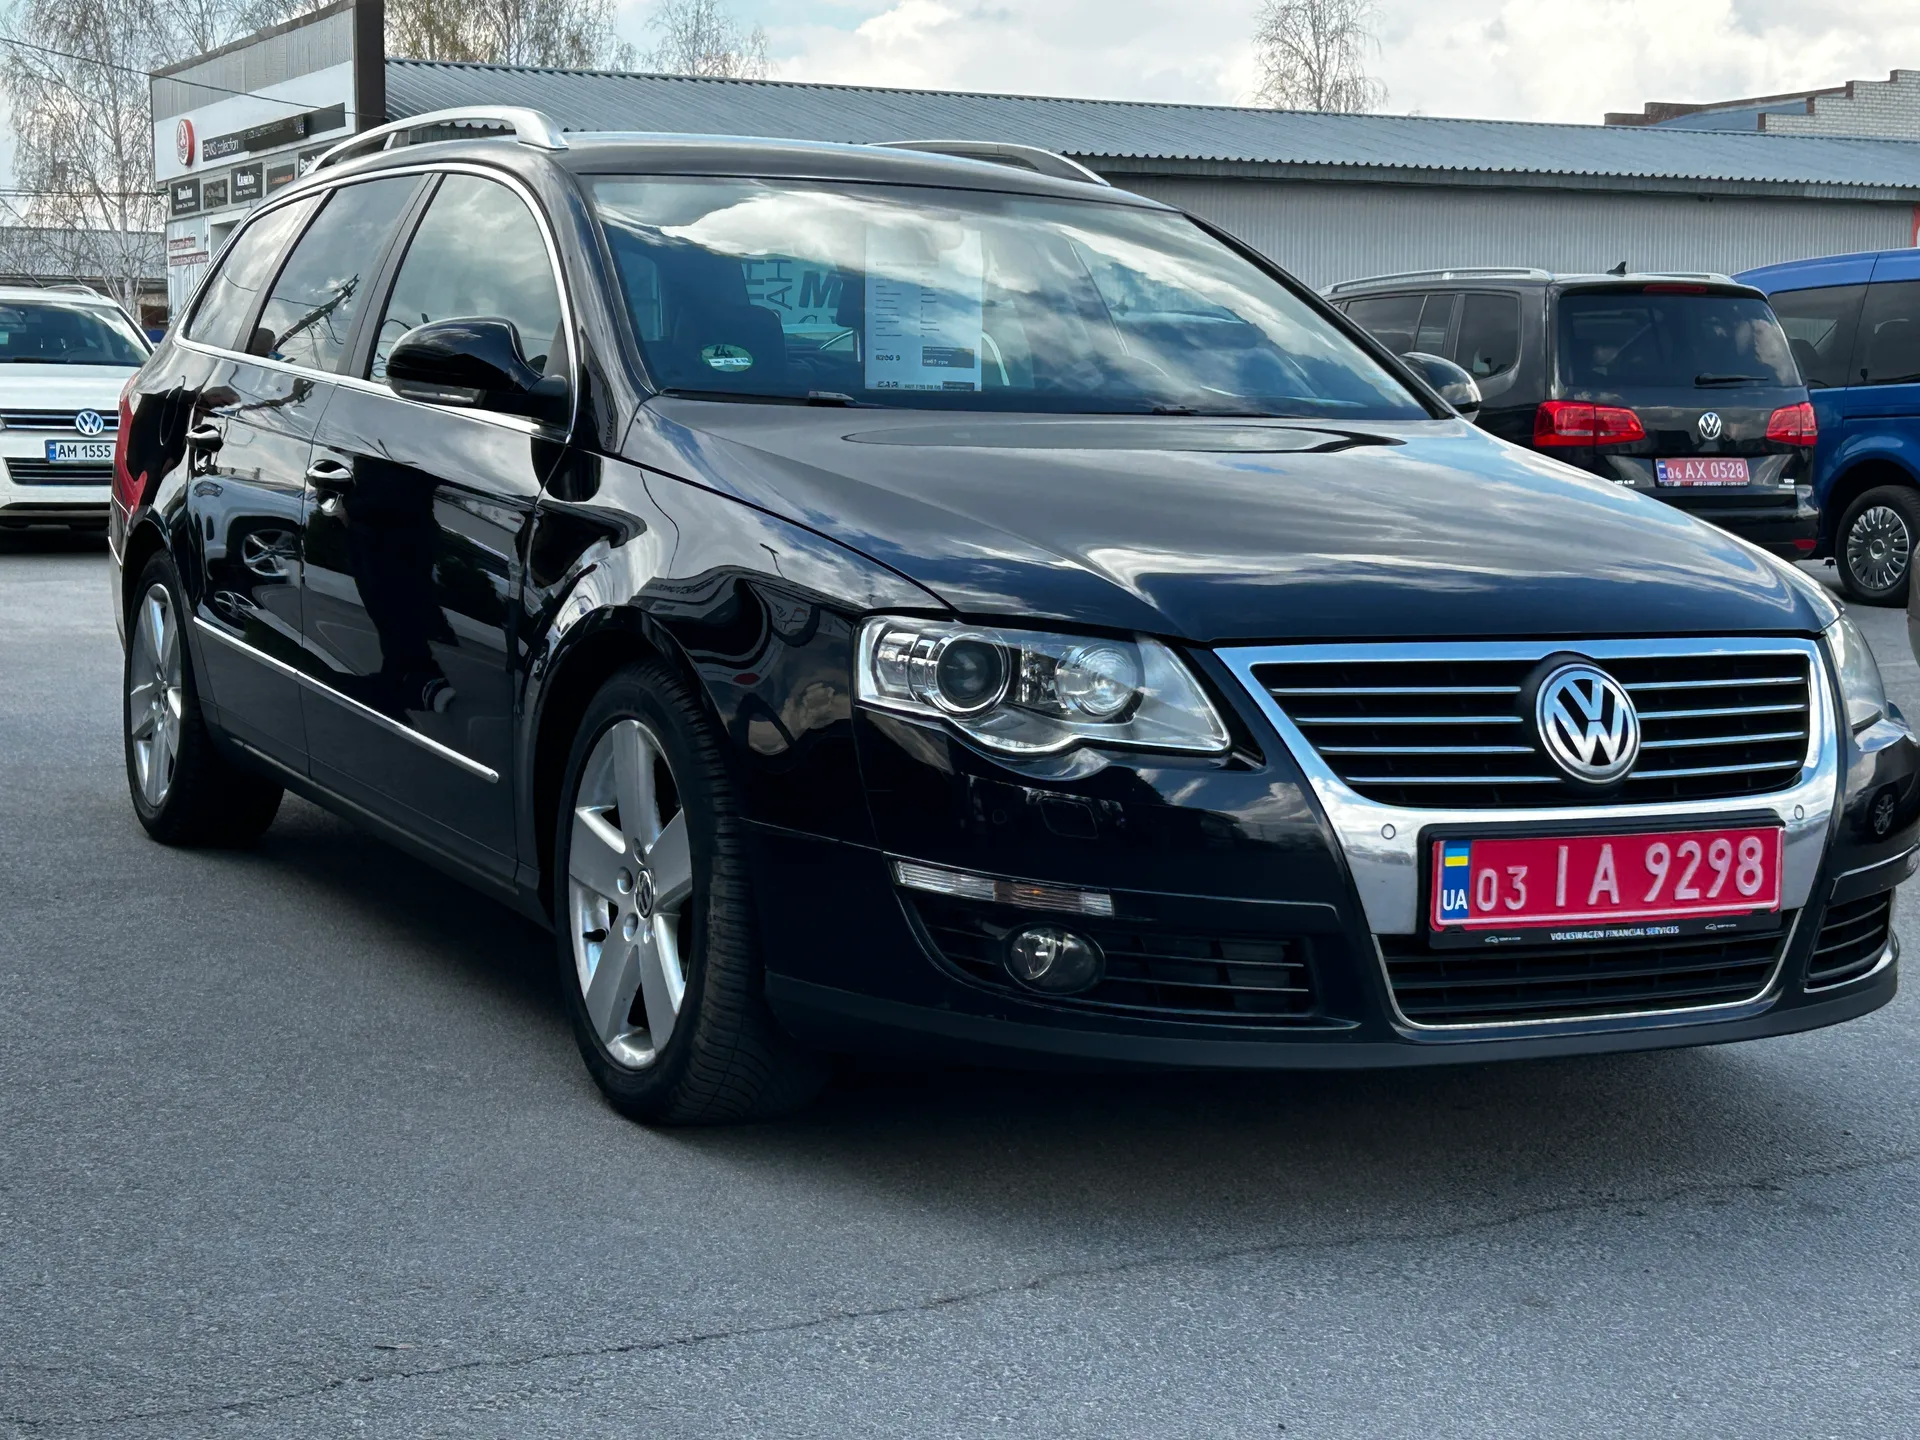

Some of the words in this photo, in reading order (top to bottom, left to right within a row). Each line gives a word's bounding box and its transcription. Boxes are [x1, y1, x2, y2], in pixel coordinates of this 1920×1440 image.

[58, 445, 77, 458] AM
[82, 445, 111, 458] 1555
[1667, 467, 1682, 479] 06
[1685, 461, 1707, 479] AX
[1710, 462, 1744, 479] 0528
[1536, 663, 1641, 784] VW
[1476, 865, 1528, 912] 03
[1643, 836, 1764, 902] 9298
[1442, 888, 1468, 911] UA
[1550, 930, 1604, 941] VOLKSWAGEN
[1606, 928, 1645, 938] FINANCIAL
[1646, 926, 1680, 935] SERVICES
